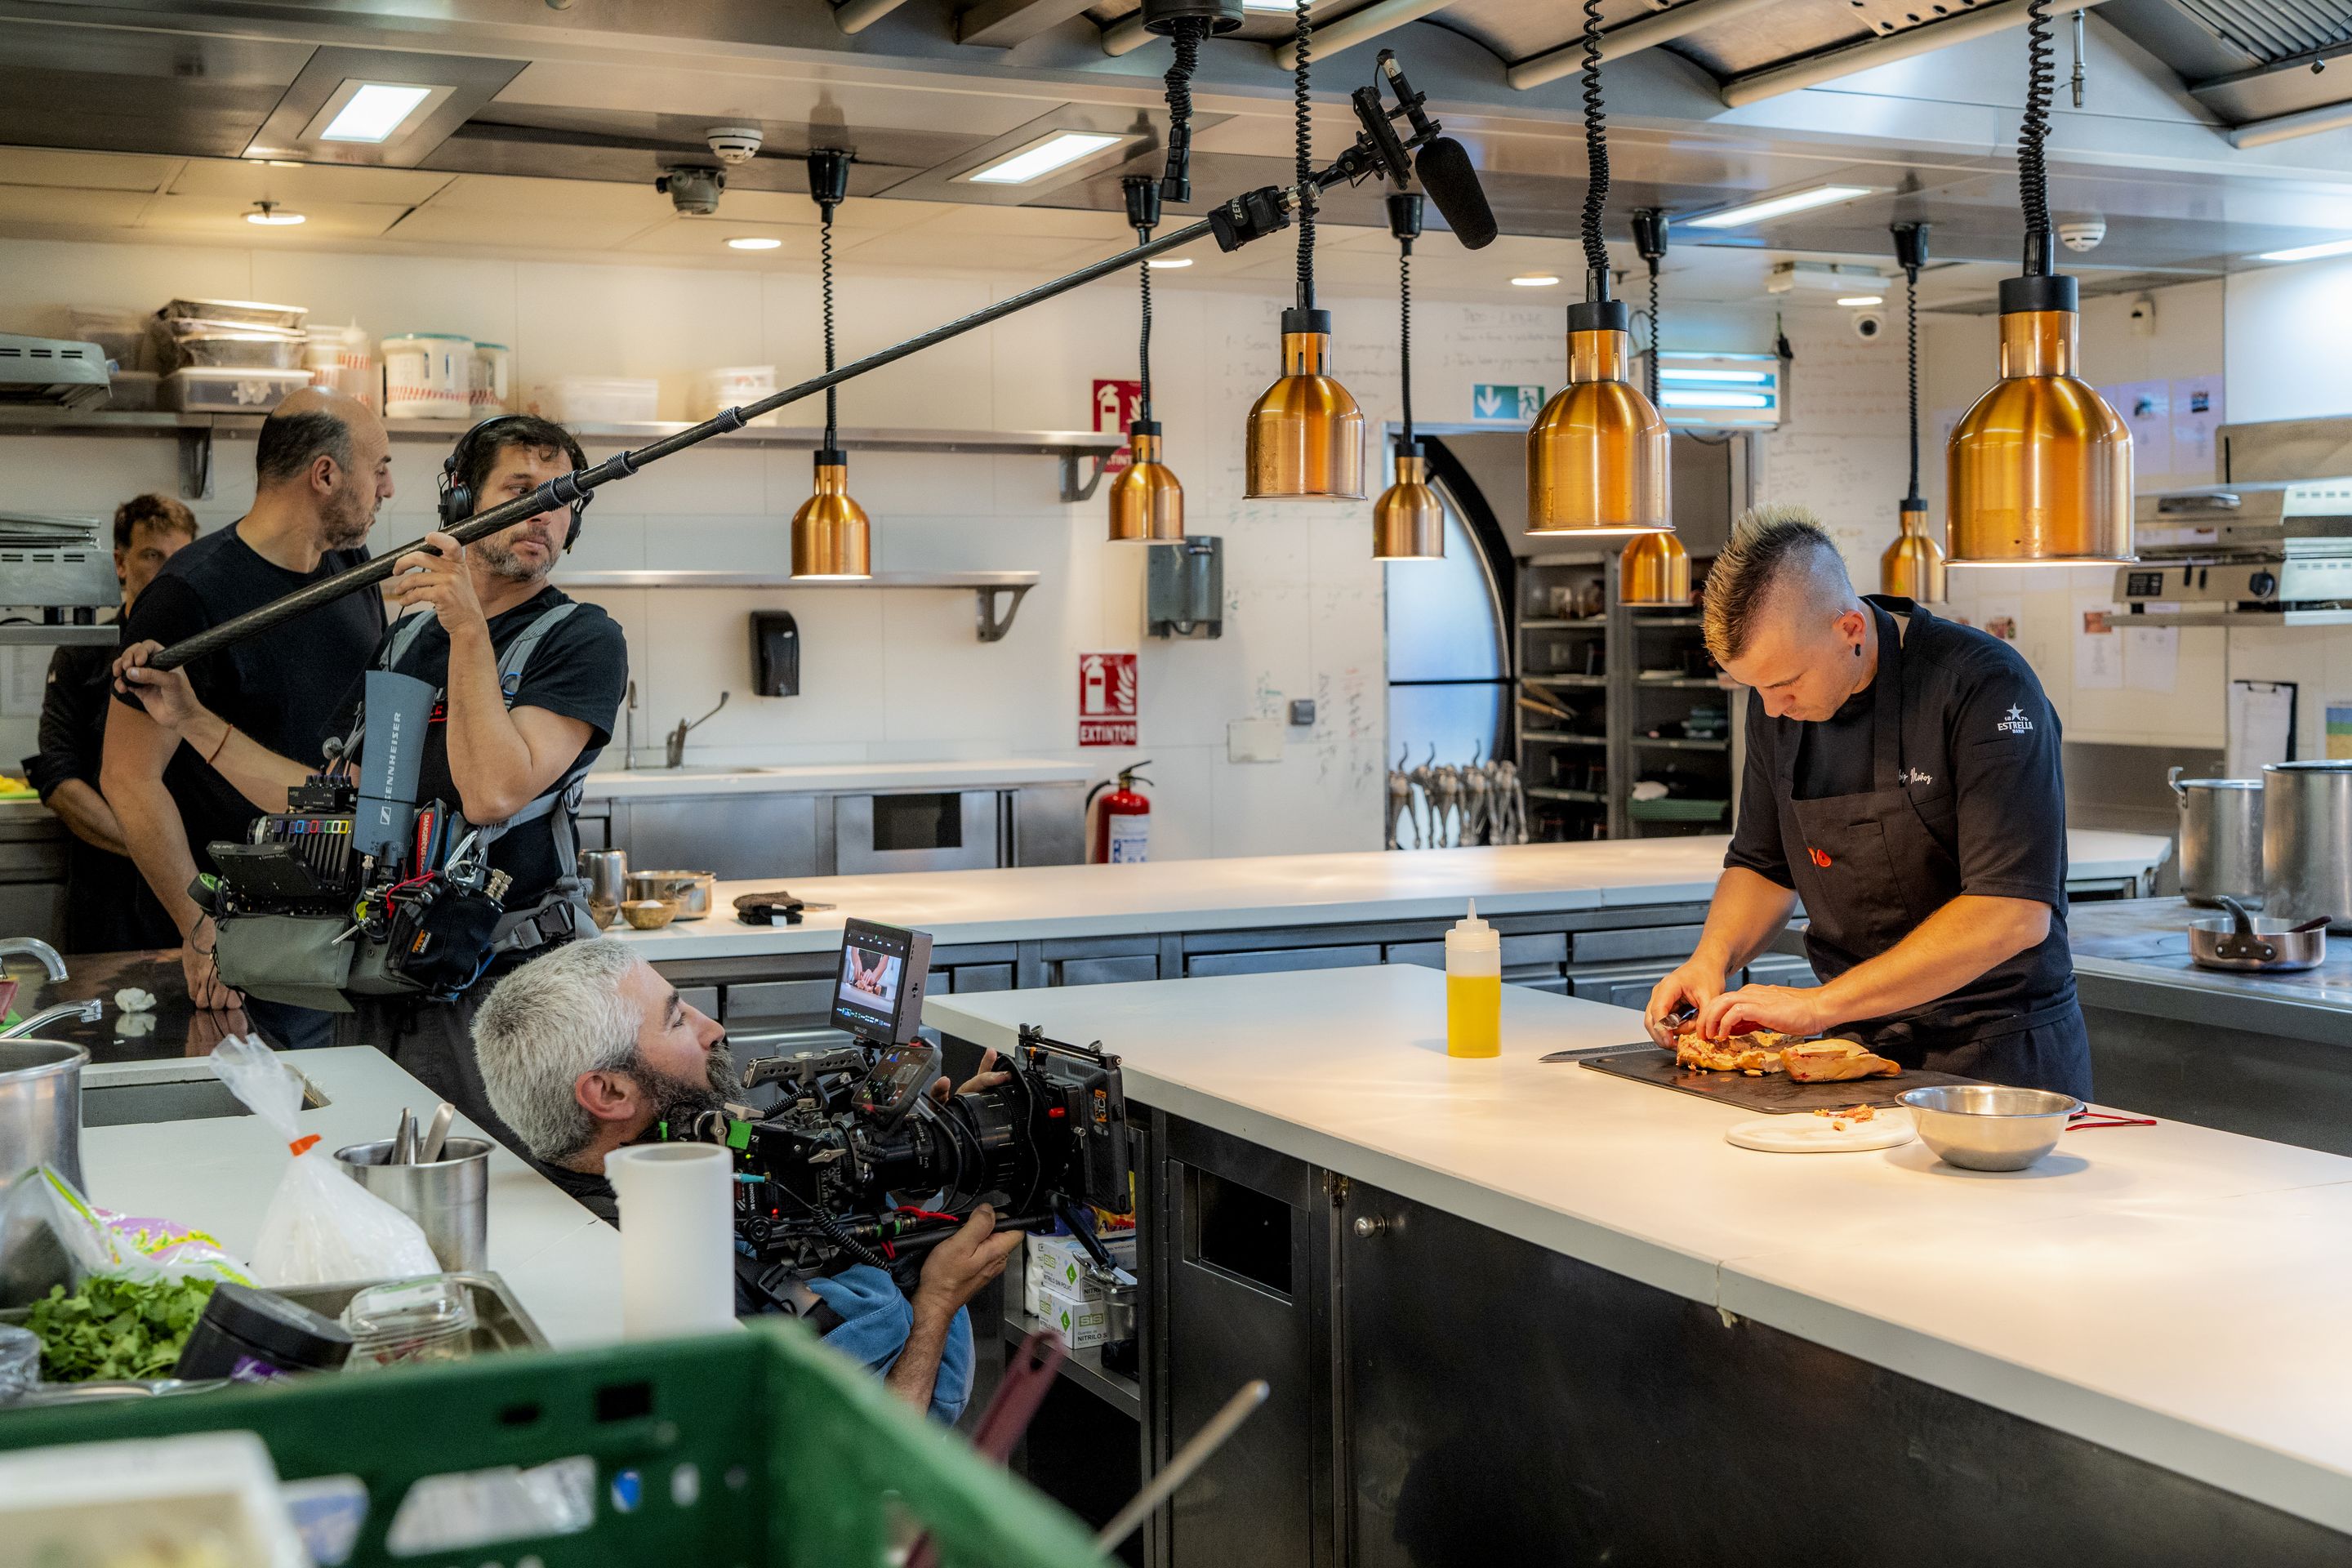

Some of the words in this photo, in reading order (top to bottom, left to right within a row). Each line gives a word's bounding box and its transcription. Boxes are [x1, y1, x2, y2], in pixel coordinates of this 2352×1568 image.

[1080, 725, 1136, 742] EXTINTOR
[1997, 721, 2034, 731] ESTRELLA
[384, 712, 401, 803] SENNHEISER
[421, 814, 430, 857] DANGEROUS
[1078, 1333, 1102, 1342] NITRILO
